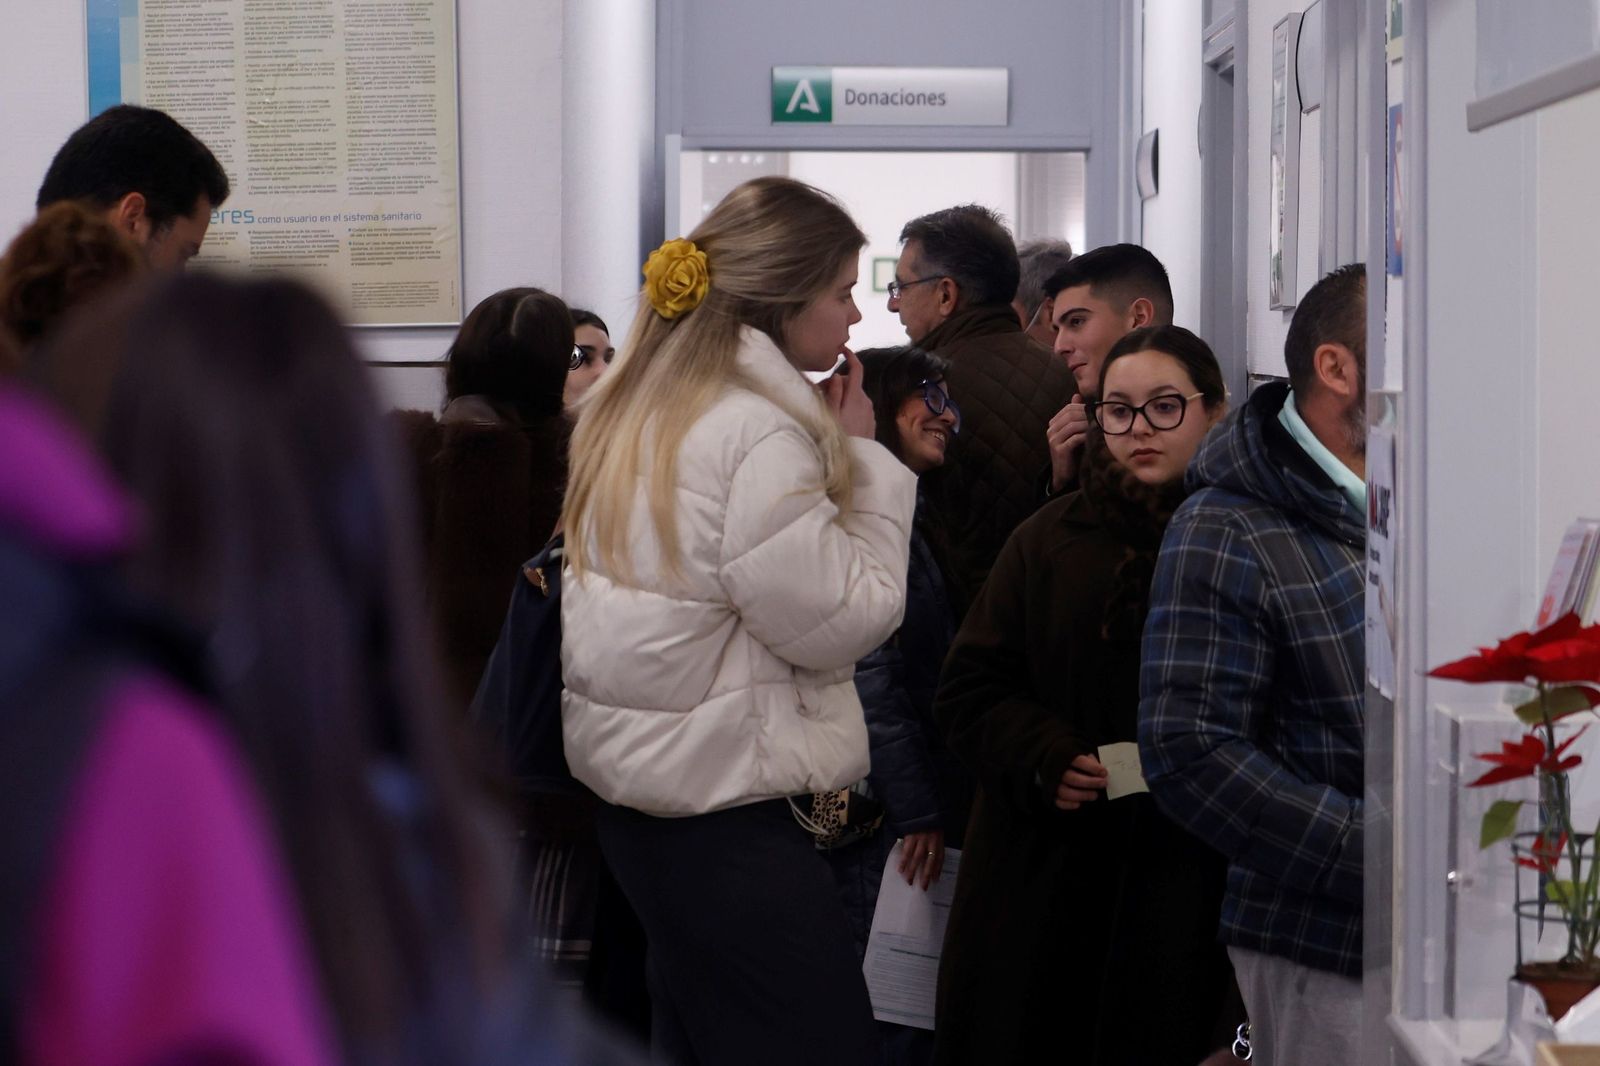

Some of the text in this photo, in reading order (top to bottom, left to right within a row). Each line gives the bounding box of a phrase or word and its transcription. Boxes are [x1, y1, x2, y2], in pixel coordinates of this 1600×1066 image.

[844, 88, 946, 106] Donaciones
[257, 216, 281, 224] como
[283, 214, 318, 224] usuario
[319, 215, 331, 223] en
[333, 213, 341, 222] el
[343, 211, 379, 222] sistema
[381, 211, 422, 221] sanitario
